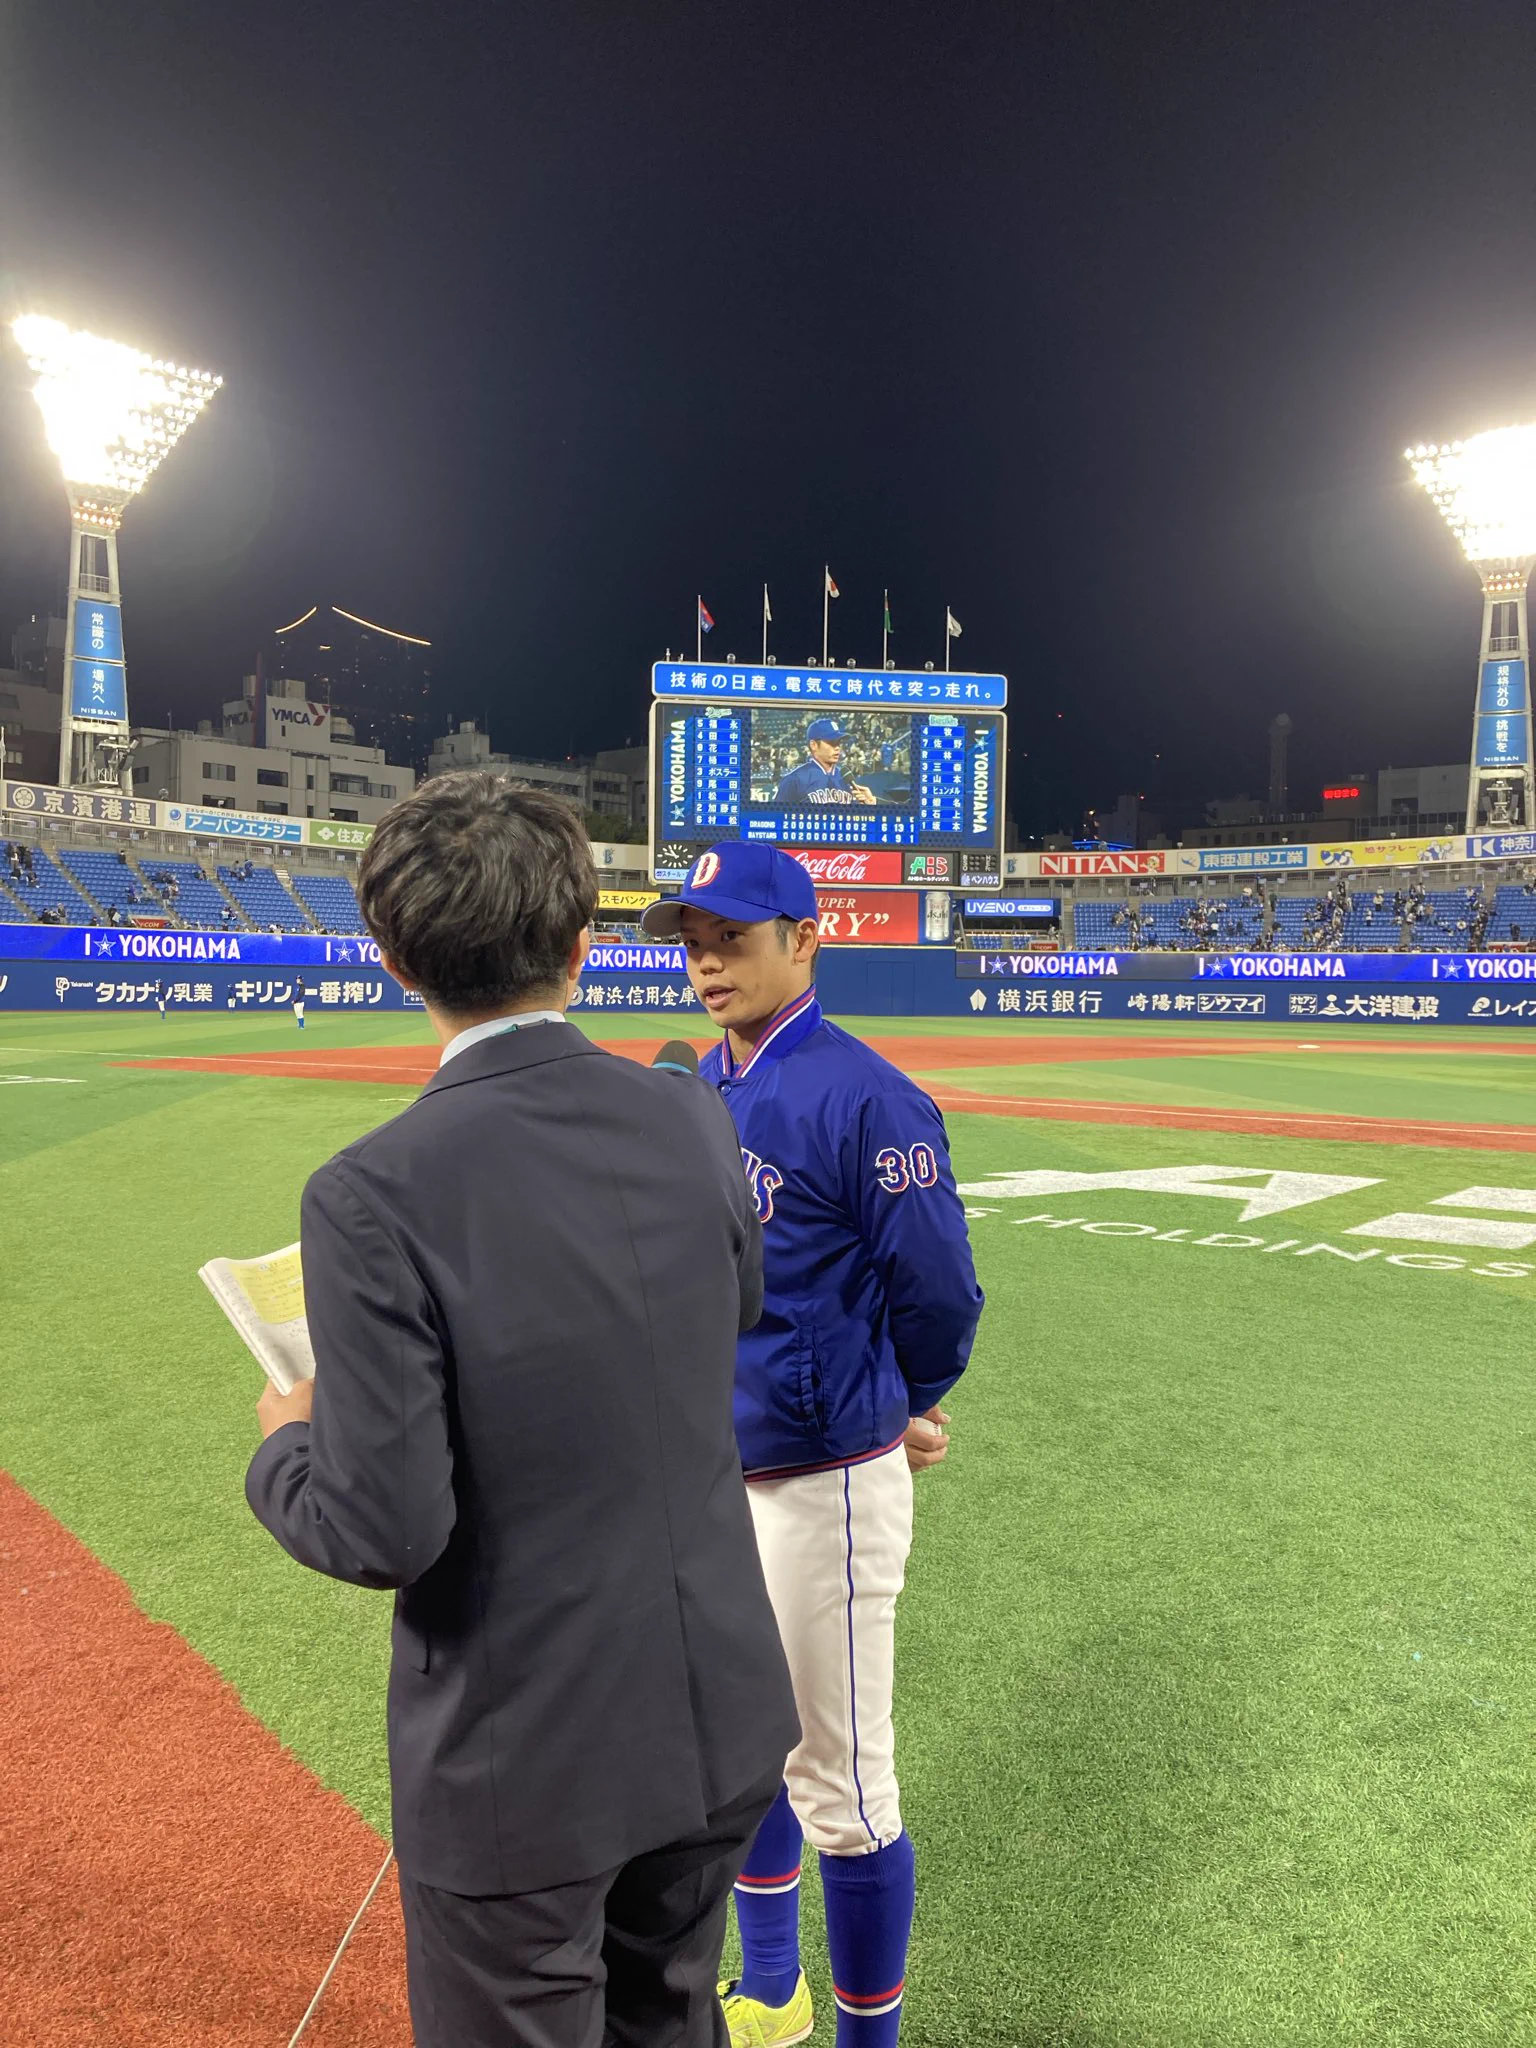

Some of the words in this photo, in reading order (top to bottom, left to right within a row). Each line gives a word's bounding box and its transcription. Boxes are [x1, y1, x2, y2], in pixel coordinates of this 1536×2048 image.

[92, 612, 104, 650] 常識の
[92, 668, 104, 704] 場外へ
[1497, 666, 1509, 708] 規格外の
[80, 707, 116, 716] NISSAN
[272, 708, 310, 726] YMCA
[1496, 720, 1508, 753] 挑戦を
[670, 720, 685, 804] YOKOHAMA
[973, 752, 988, 833] YOKOHAMA
[43, 792, 151, 824] 京濱港運
[188, 816, 300, 838] アーバンエナジー
[691, 852, 721, 888] D
[1042, 856, 1139, 874] NITTAN
[1204, 850, 1304, 868] 東亜建設工業
[816, 898, 856, 909] UPER
[967, 902, 1015, 913] UYENO
[119, 934, 240, 960] YOKOHAMA
[582, 948, 684, 969] OKOHAMA
[1009, 956, 1118, 975] YOKOHAMA
[1230, 957, 1346, 977] YOKOHAMA
[585, 984, 697, 1006] 横浜信用金庫
[997, 989, 1102, 1014] 横浜銀行
[1200, 996, 1263, 1012] シウマイ
[1291, 996, 1316, 1004] オセアン
[1345, 994, 1439, 1017] 大洋建設
[1291, 1005, 1316, 1013] グループ
[875, 1143, 938, 1194] 30
[1011, 1214, 1534, 1278] HOLDINGS
